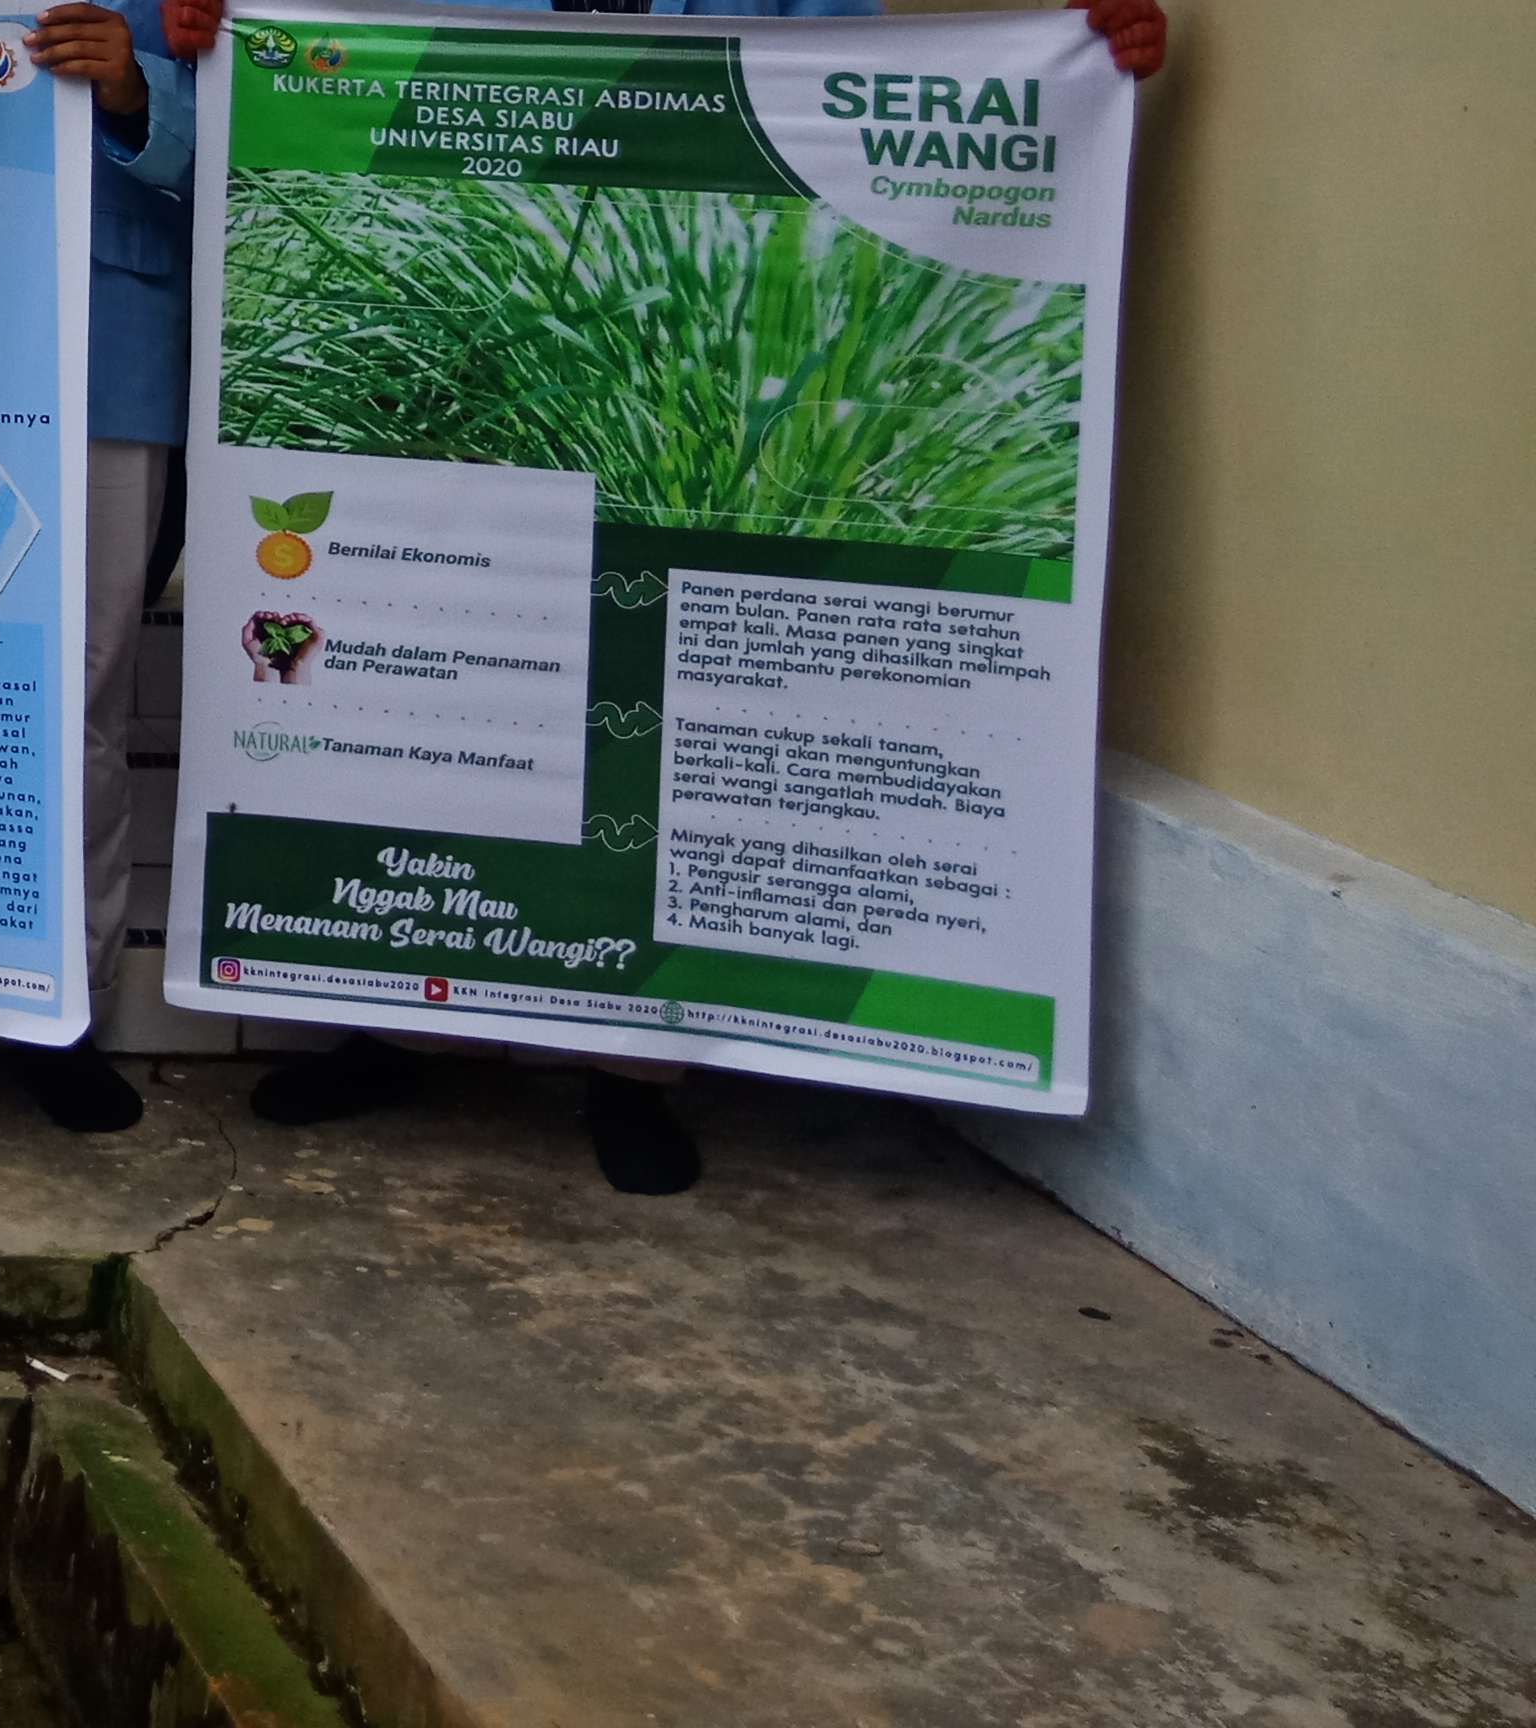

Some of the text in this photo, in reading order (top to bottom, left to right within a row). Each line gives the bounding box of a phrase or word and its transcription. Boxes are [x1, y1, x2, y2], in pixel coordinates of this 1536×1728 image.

[274, 74, 725, 113] KUKERTA TERINTEGRASI ABDIMAS
[822, 71, 1039, 127] SERAI
[417, 105, 573, 131] DESA SIABU
[370, 127, 618, 158] UNIVERSITAS RIAU
[860, 128, 1056, 173] WANGI
[461, 156, 522, 177] 2020
[870, 175, 1056, 206] Cymbopogon
[952, 206, 1052, 229] Nardus
[328, 541, 491, 568] Bernilai Ekonomis
[682, 581, 1015, 622] Panen perdana serai wangi berumur
[324, 639, 560, 673] Mudah dalam Penanaman
[324, 655, 458, 680] dan Perawatan
[234, 730, 309, 756] NATURAL
[322, 737, 534, 771] Tanaman Kaya Manfaat
[377, 846, 475, 881] Yakin
[332, 877, 518, 920] Nggak Mau
[688, 865, 761, 885] Pengusir
[767, 874, 853, 898] serangga
[858, 884, 915, 905] alami,
[224, 902, 636, 970] Menanam Serai Wangi??
[453, 986, 657, 1016] KKN Integrasi Desa Siabu 2020
